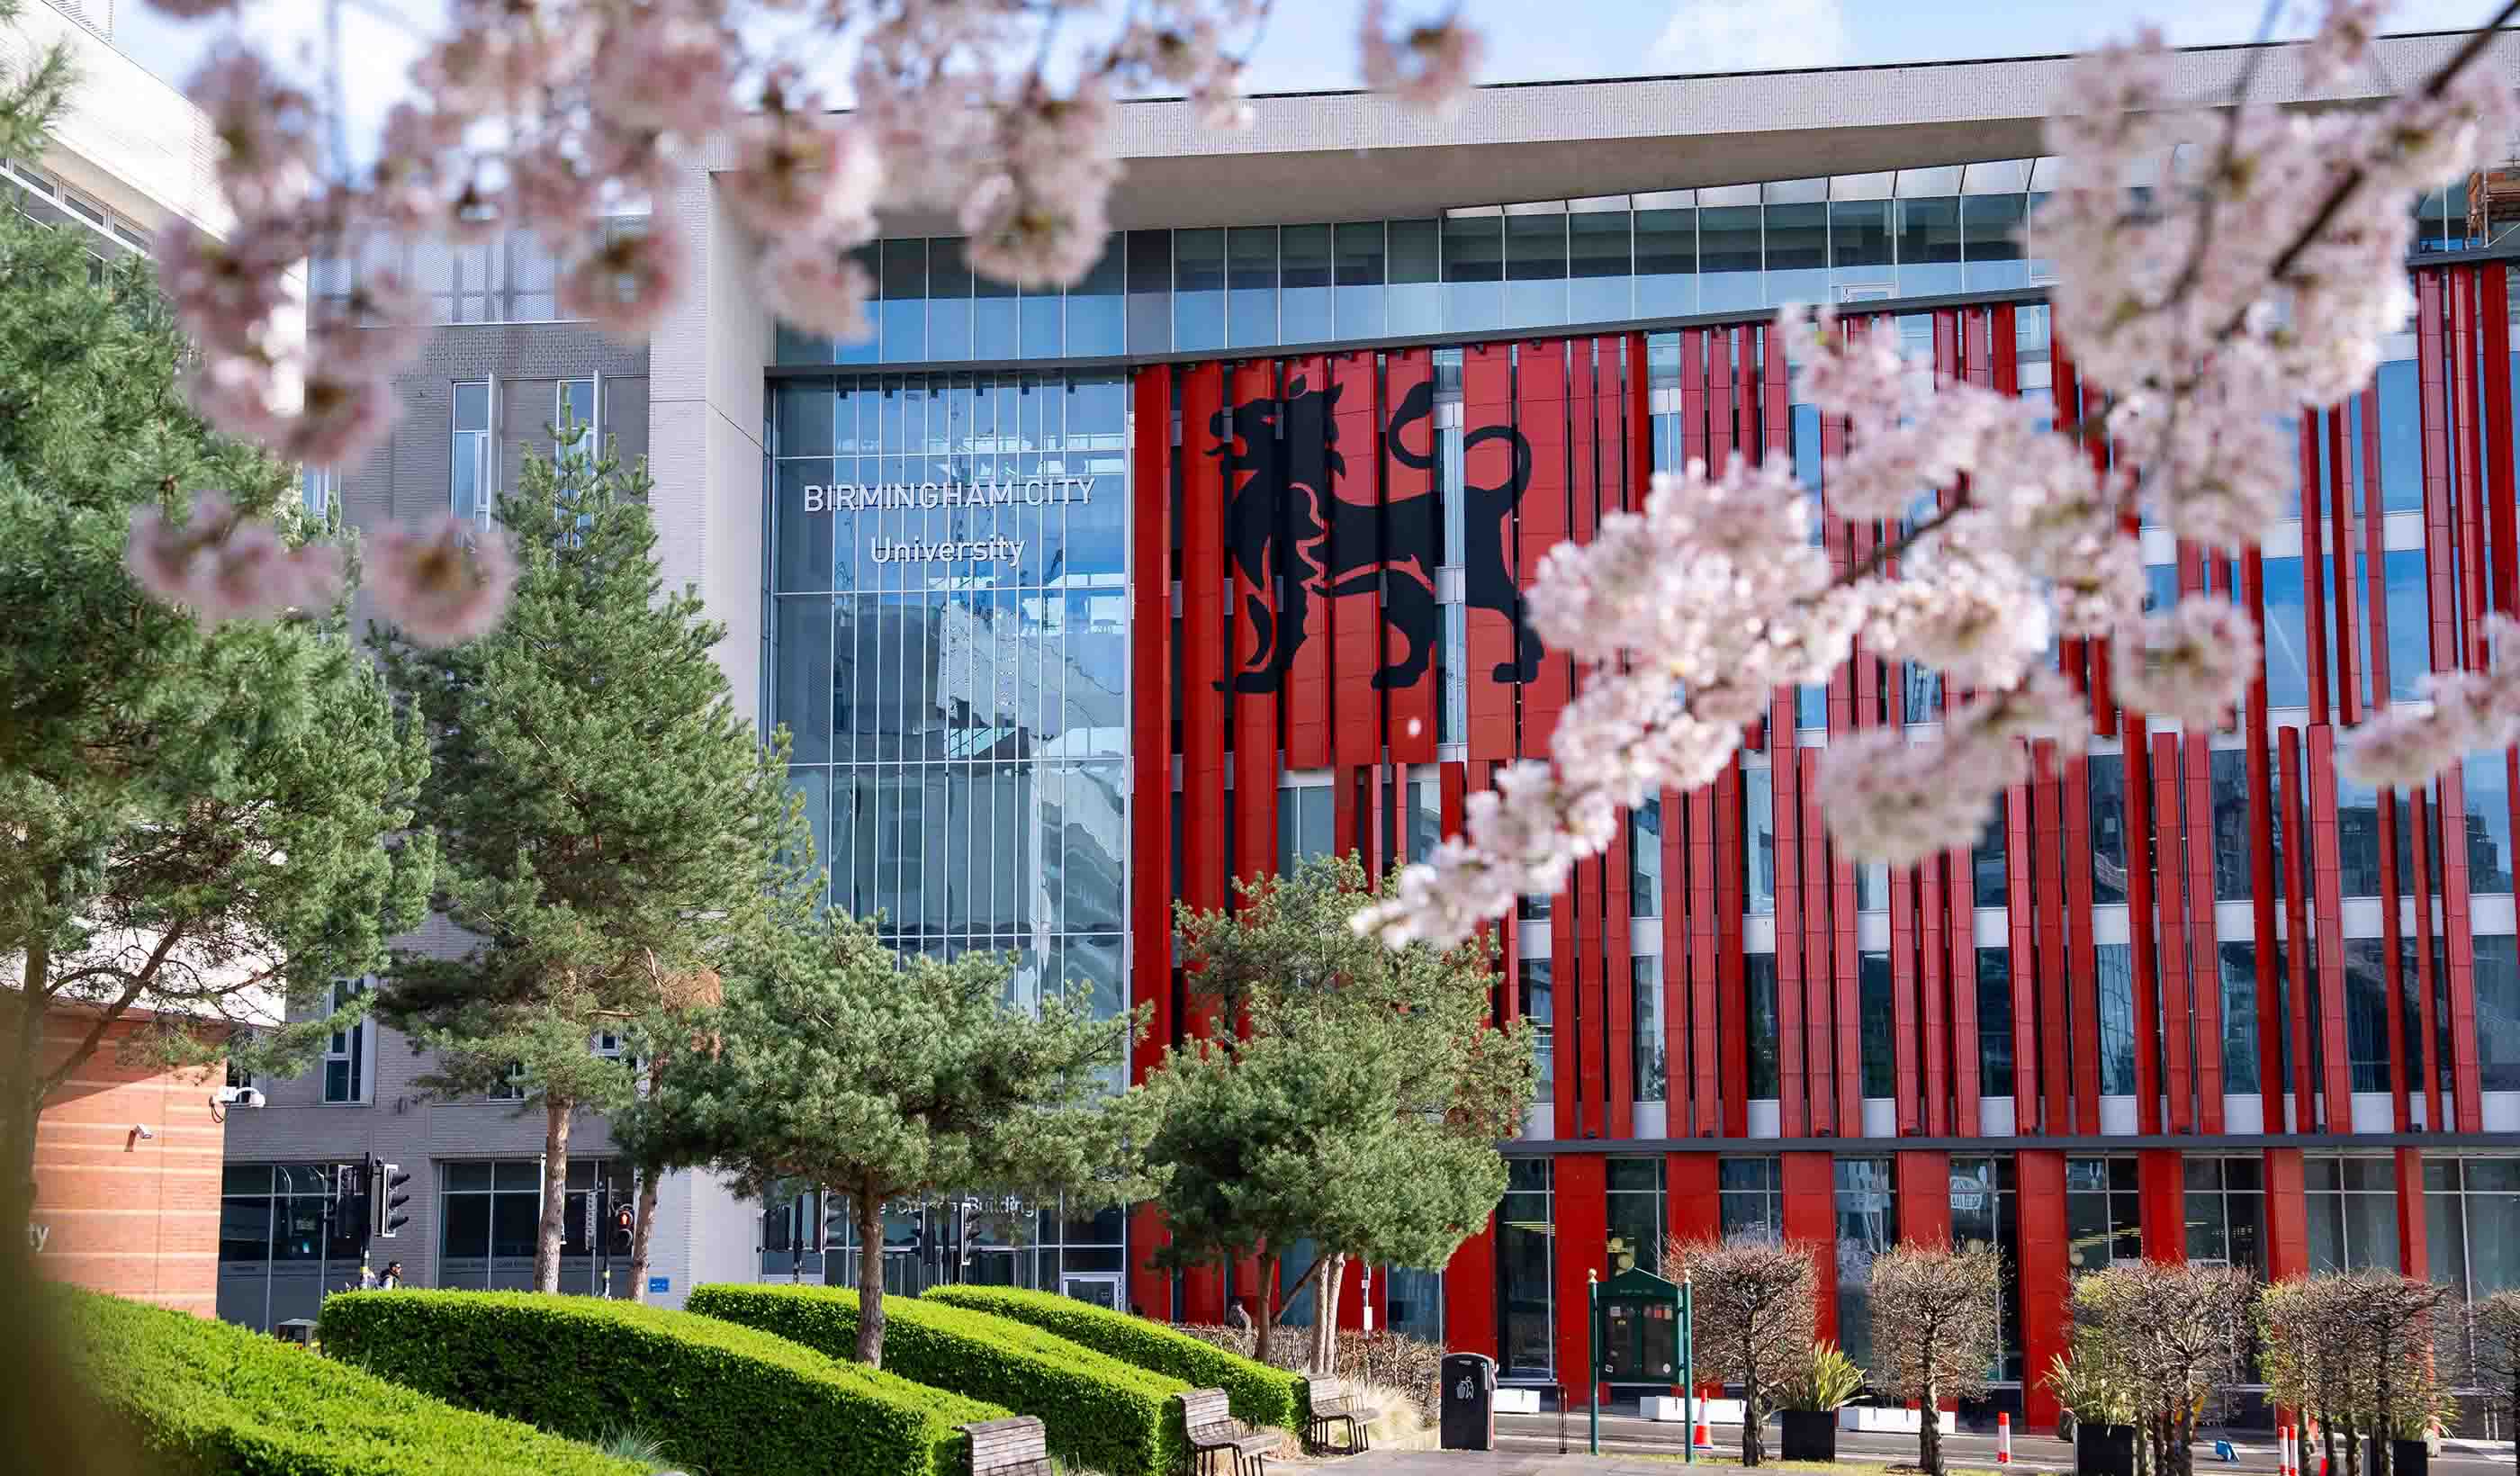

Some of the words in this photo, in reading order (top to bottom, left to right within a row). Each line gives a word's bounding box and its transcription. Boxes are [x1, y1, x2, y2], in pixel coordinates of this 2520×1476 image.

[805, 481, 1012, 512] BIRMINGHAM
[1024, 478, 1095, 506] CITY
[871, 535, 1027, 568] University
